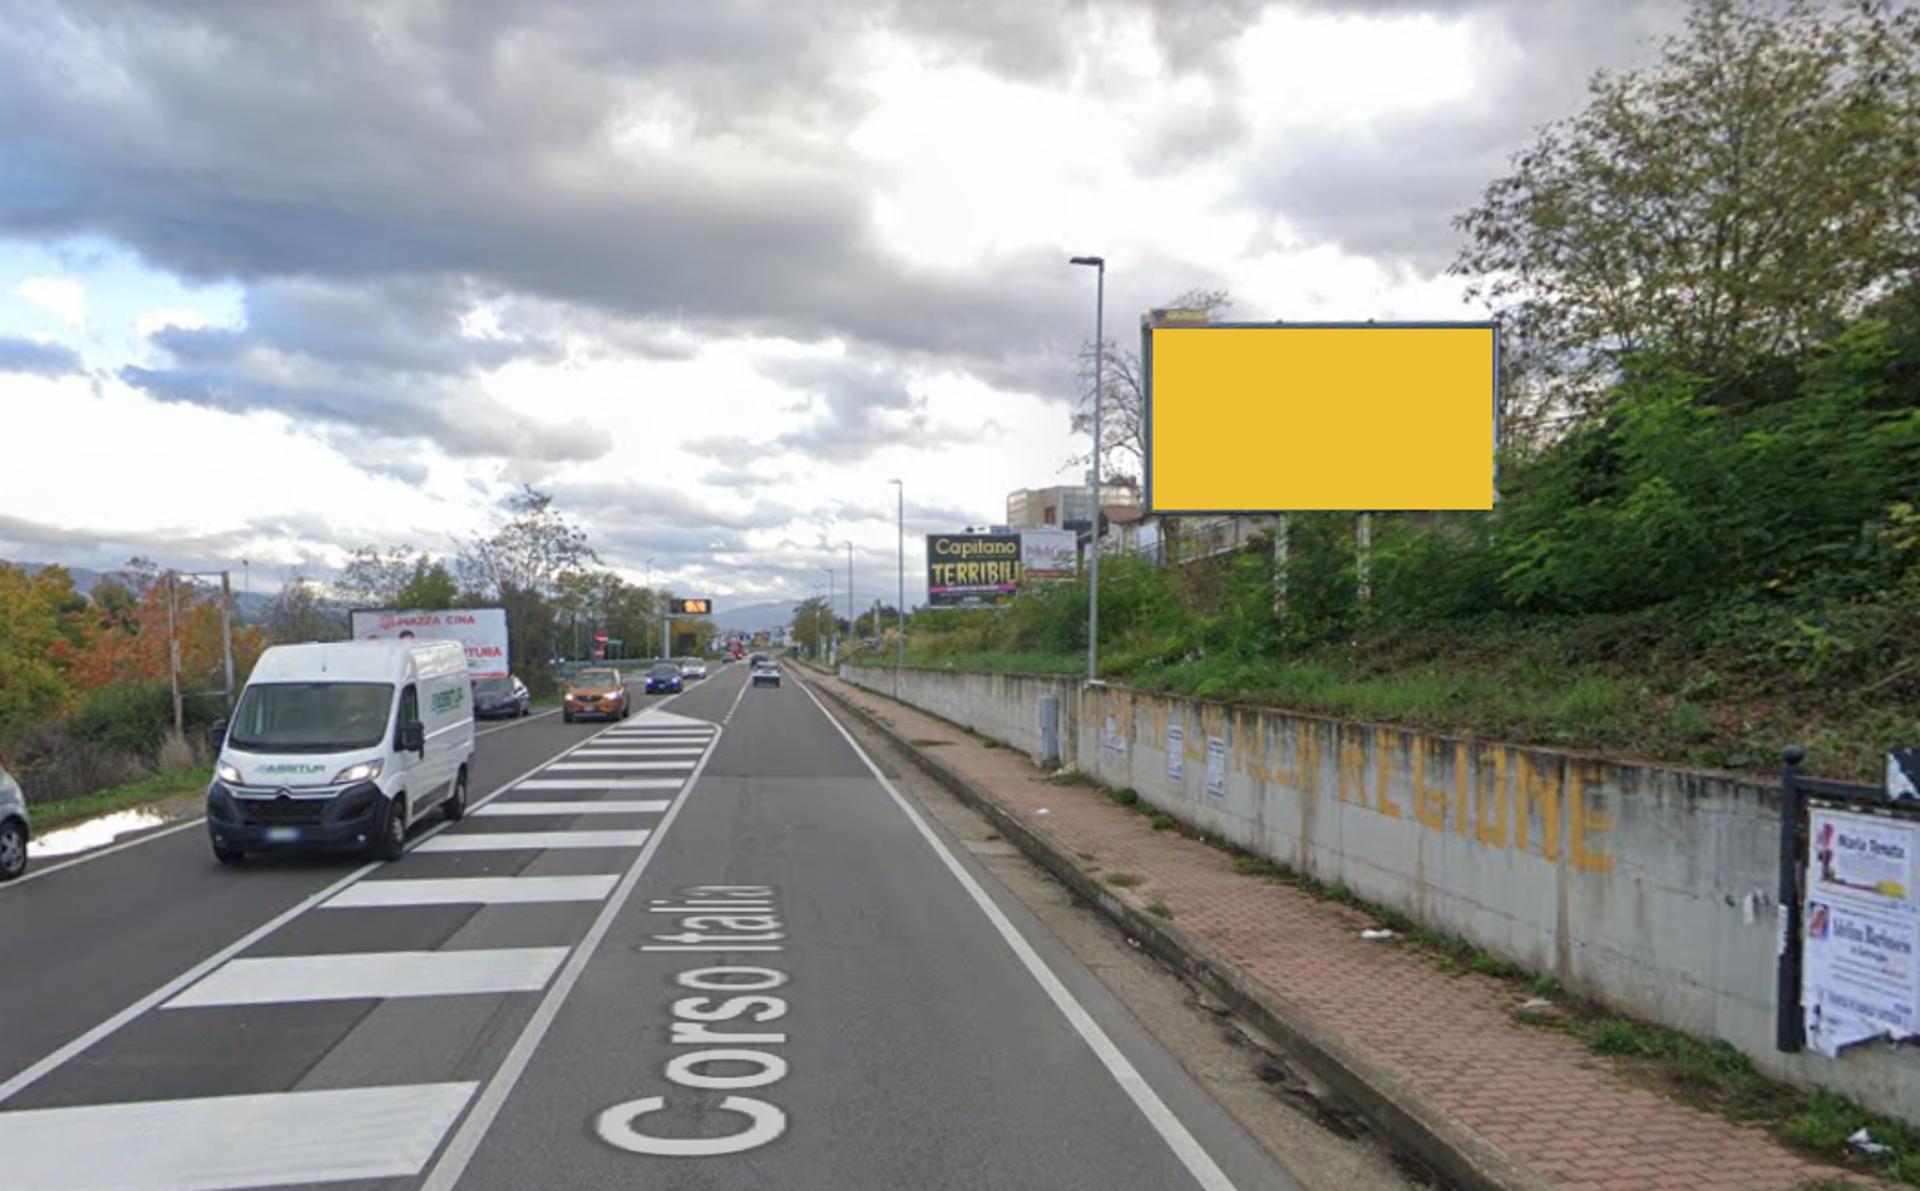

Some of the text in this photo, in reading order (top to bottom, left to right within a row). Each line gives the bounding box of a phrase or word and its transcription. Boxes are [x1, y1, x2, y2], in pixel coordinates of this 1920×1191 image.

[935, 538, 1017, 558] Capitano
[446, 615, 475, 625] CINA
[1339, 728, 1616, 873] REGIONE
